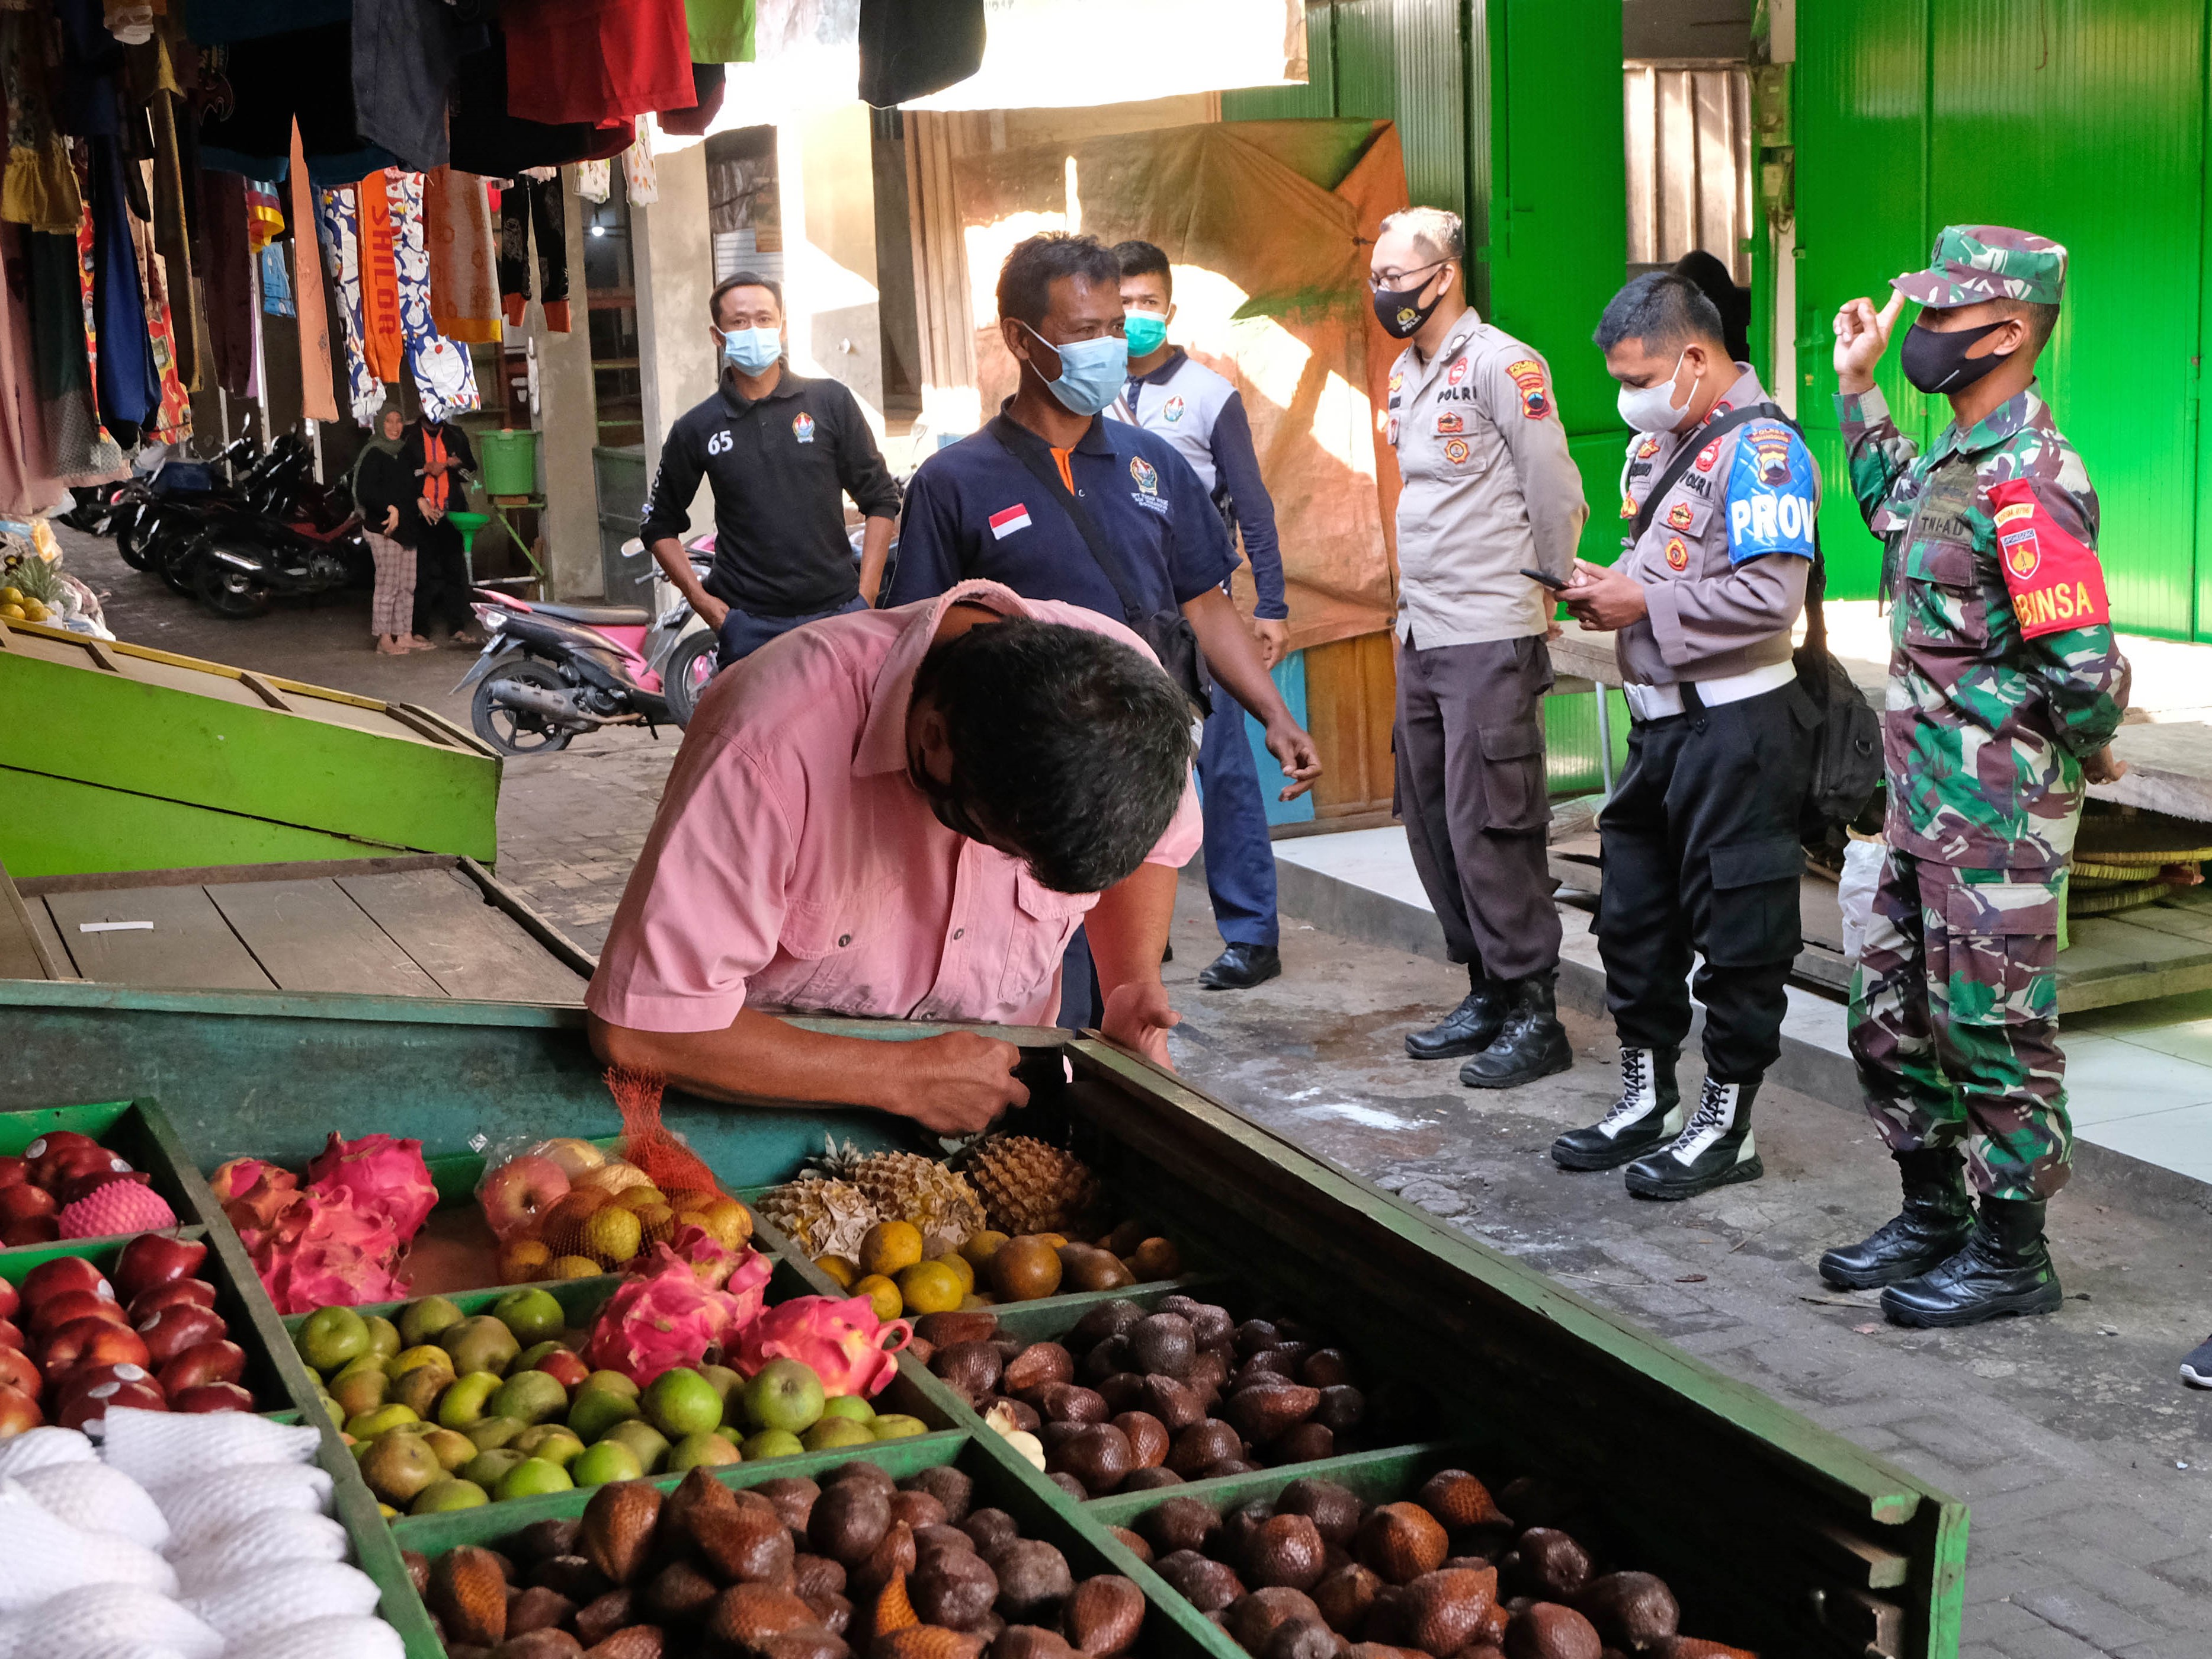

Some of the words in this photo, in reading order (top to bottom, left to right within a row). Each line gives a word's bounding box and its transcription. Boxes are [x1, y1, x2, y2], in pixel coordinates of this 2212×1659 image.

[371, 204, 396, 334] SAILOR
[1402, 315, 1422, 332] POLRI
[1437, 386, 1477, 403] POLRI
[708, 430, 733, 455] 65
[1731, 494, 1814, 546] PROV
[1921, 517, 1964, 536] TNI-AD
[2012, 581, 2094, 628] BINSA
